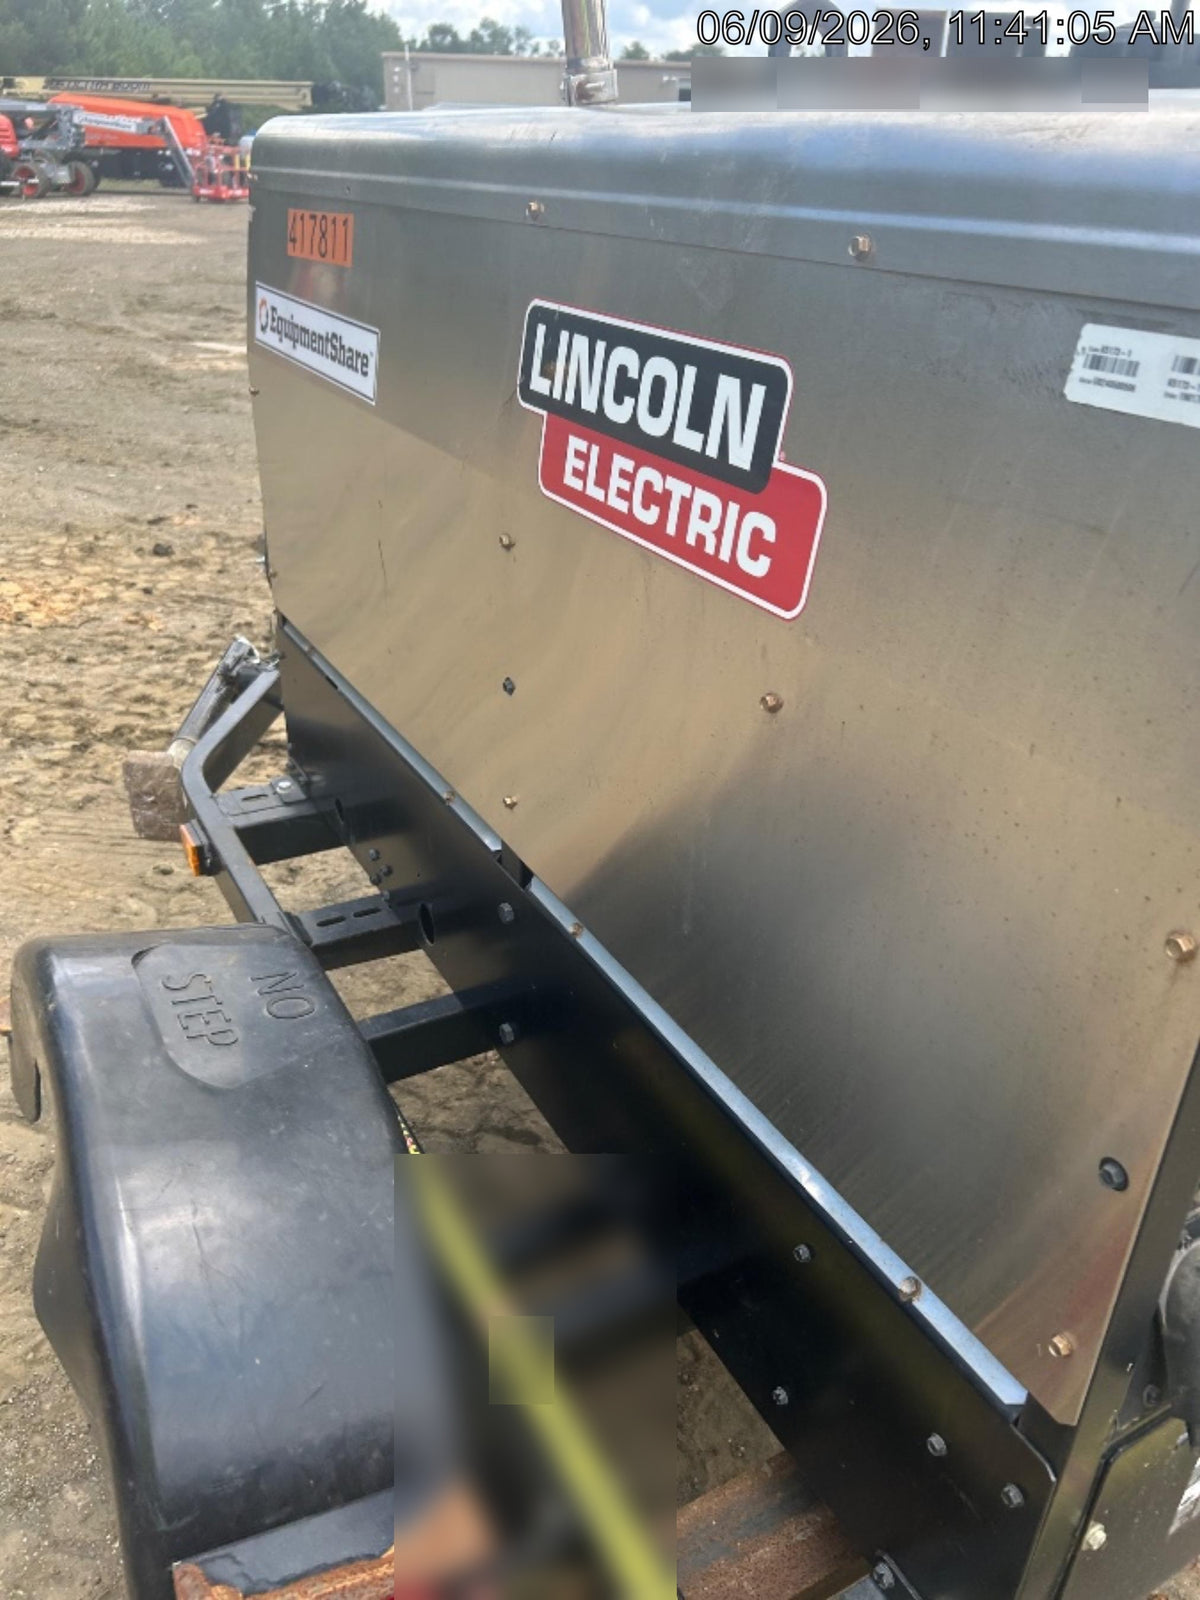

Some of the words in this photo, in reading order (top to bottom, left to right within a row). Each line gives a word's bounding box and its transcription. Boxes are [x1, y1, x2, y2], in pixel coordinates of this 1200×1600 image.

[288, 211, 349, 262] 417811
[269, 305, 369, 378] EquipmentShare
[529, 323, 766, 471] LINCOLN
[563, 434, 776, 578] ELECTRIC
[161, 973, 239, 1046] STEP
[250, 971, 316, 1019] NO
